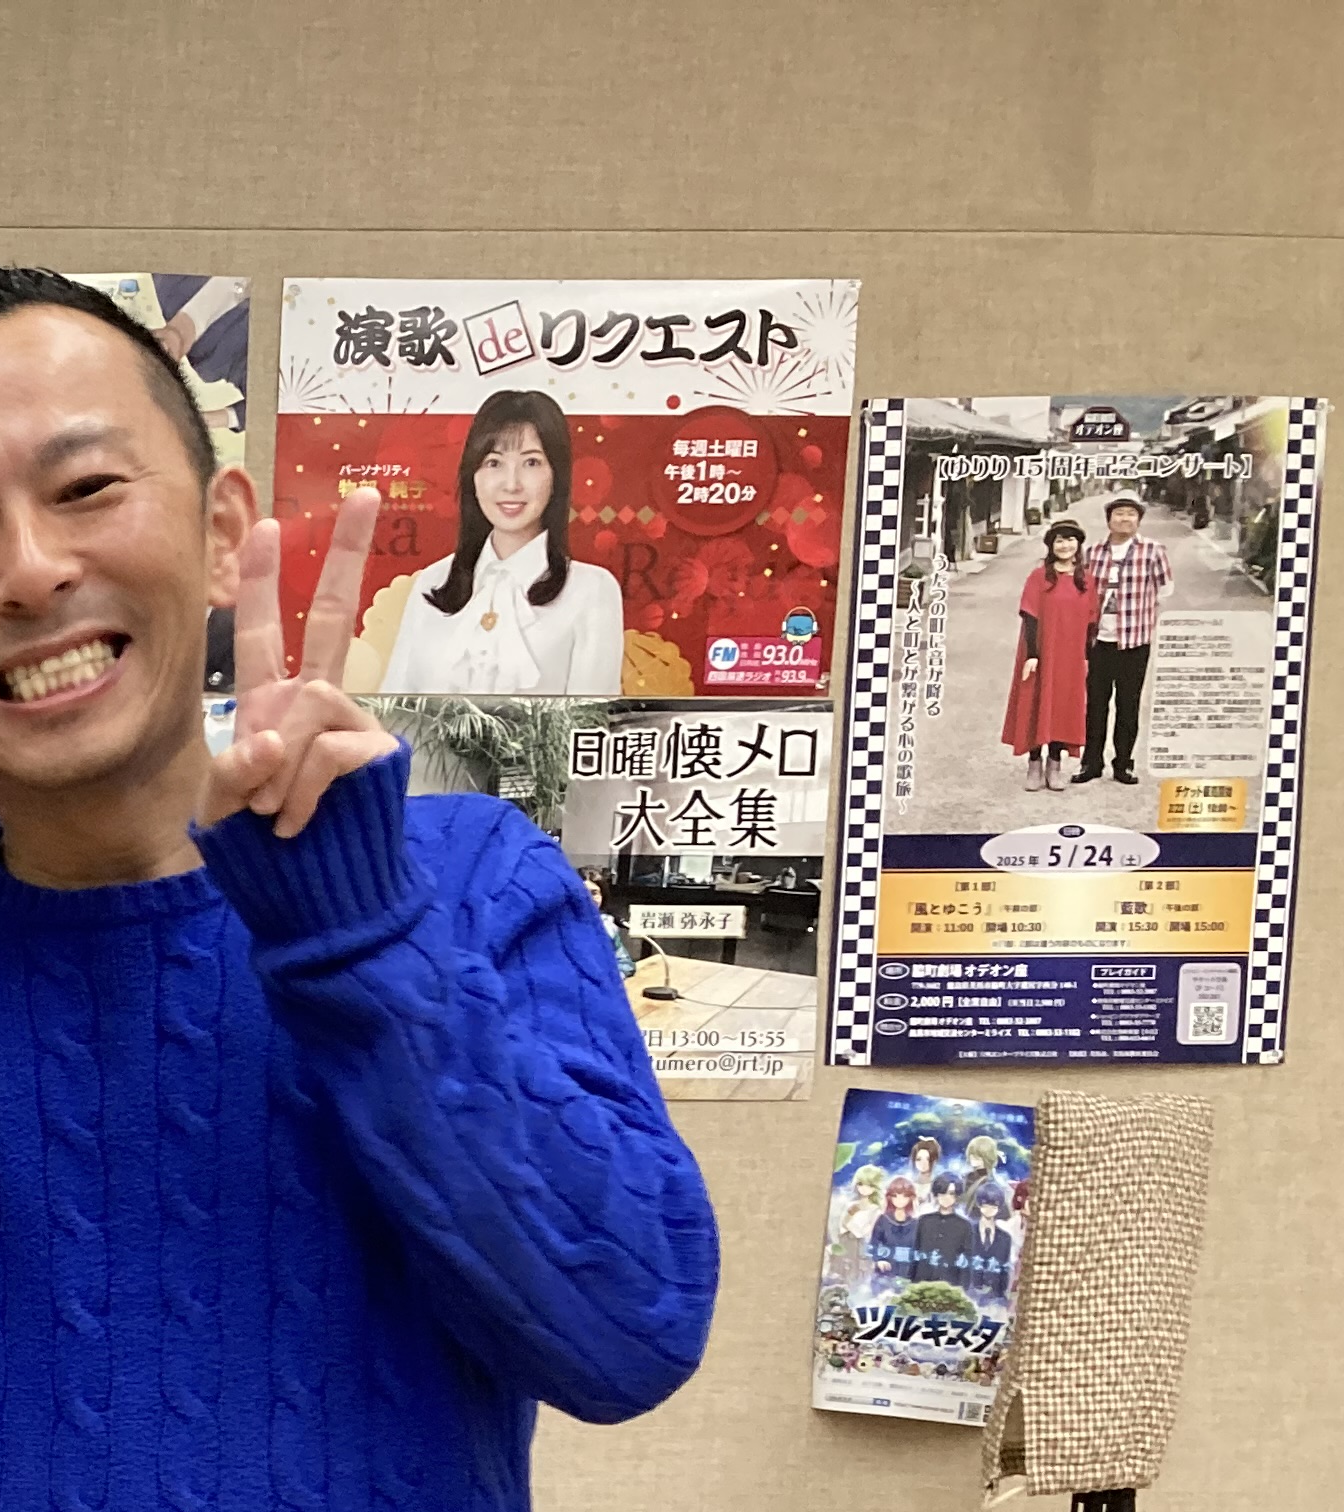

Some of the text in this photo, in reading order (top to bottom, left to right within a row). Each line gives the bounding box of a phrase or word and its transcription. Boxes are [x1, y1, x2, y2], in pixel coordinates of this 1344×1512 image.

[334, 304, 799, 367] 演歌 de リクエスト
[673, 439, 758, 457] 毎週土曜日
[339, 464, 411, 476] パーソナリティ
[676, 482, 757, 504] 2時20分
[712, 646, 737, 662] FM
[761, 644, 803, 666] 93.0
[612, 787, 779, 848] 大全集
[680, 911, 733, 930] 弥永子
[640, 1029, 785, 1048] 日 13:00〜15:55
